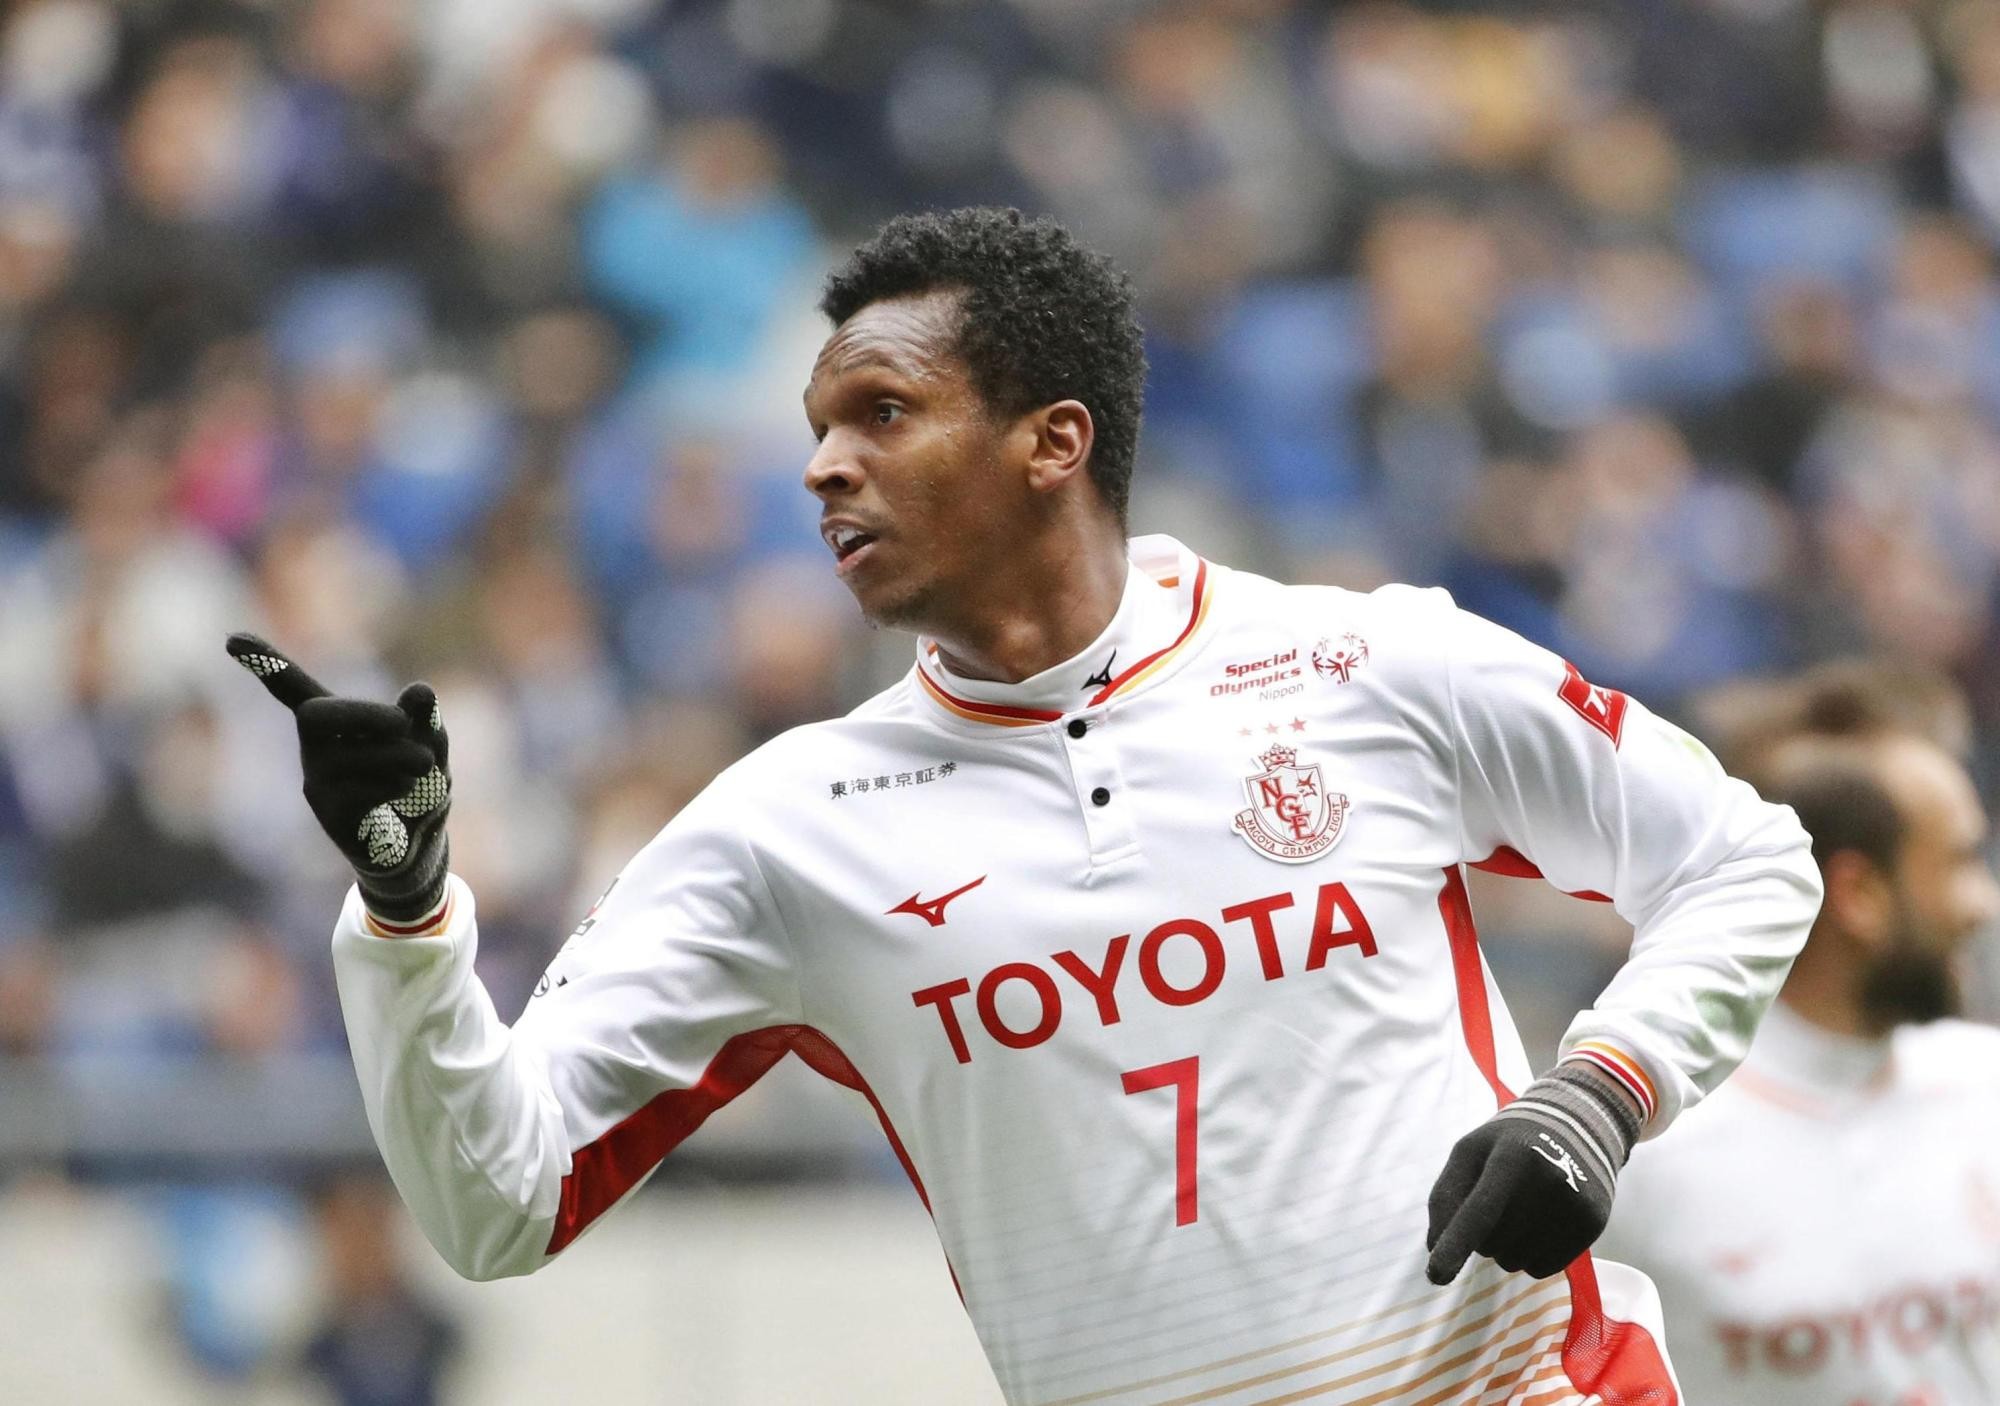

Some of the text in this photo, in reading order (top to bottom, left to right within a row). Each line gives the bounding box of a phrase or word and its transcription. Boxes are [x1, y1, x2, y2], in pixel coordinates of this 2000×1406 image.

[1210, 667, 1302, 697] Olympics
[1225, 648, 1297, 677] Special
[1259, 683, 1304, 701] Nippon
[829, 761, 957, 800] 東海東京証券
[1245, 802, 1342, 856] NAGOYA GRAMPUS EIGHT
[912, 882, 1379, 1064] TOYOTA
[1121, 1056, 1199, 1227] 7
